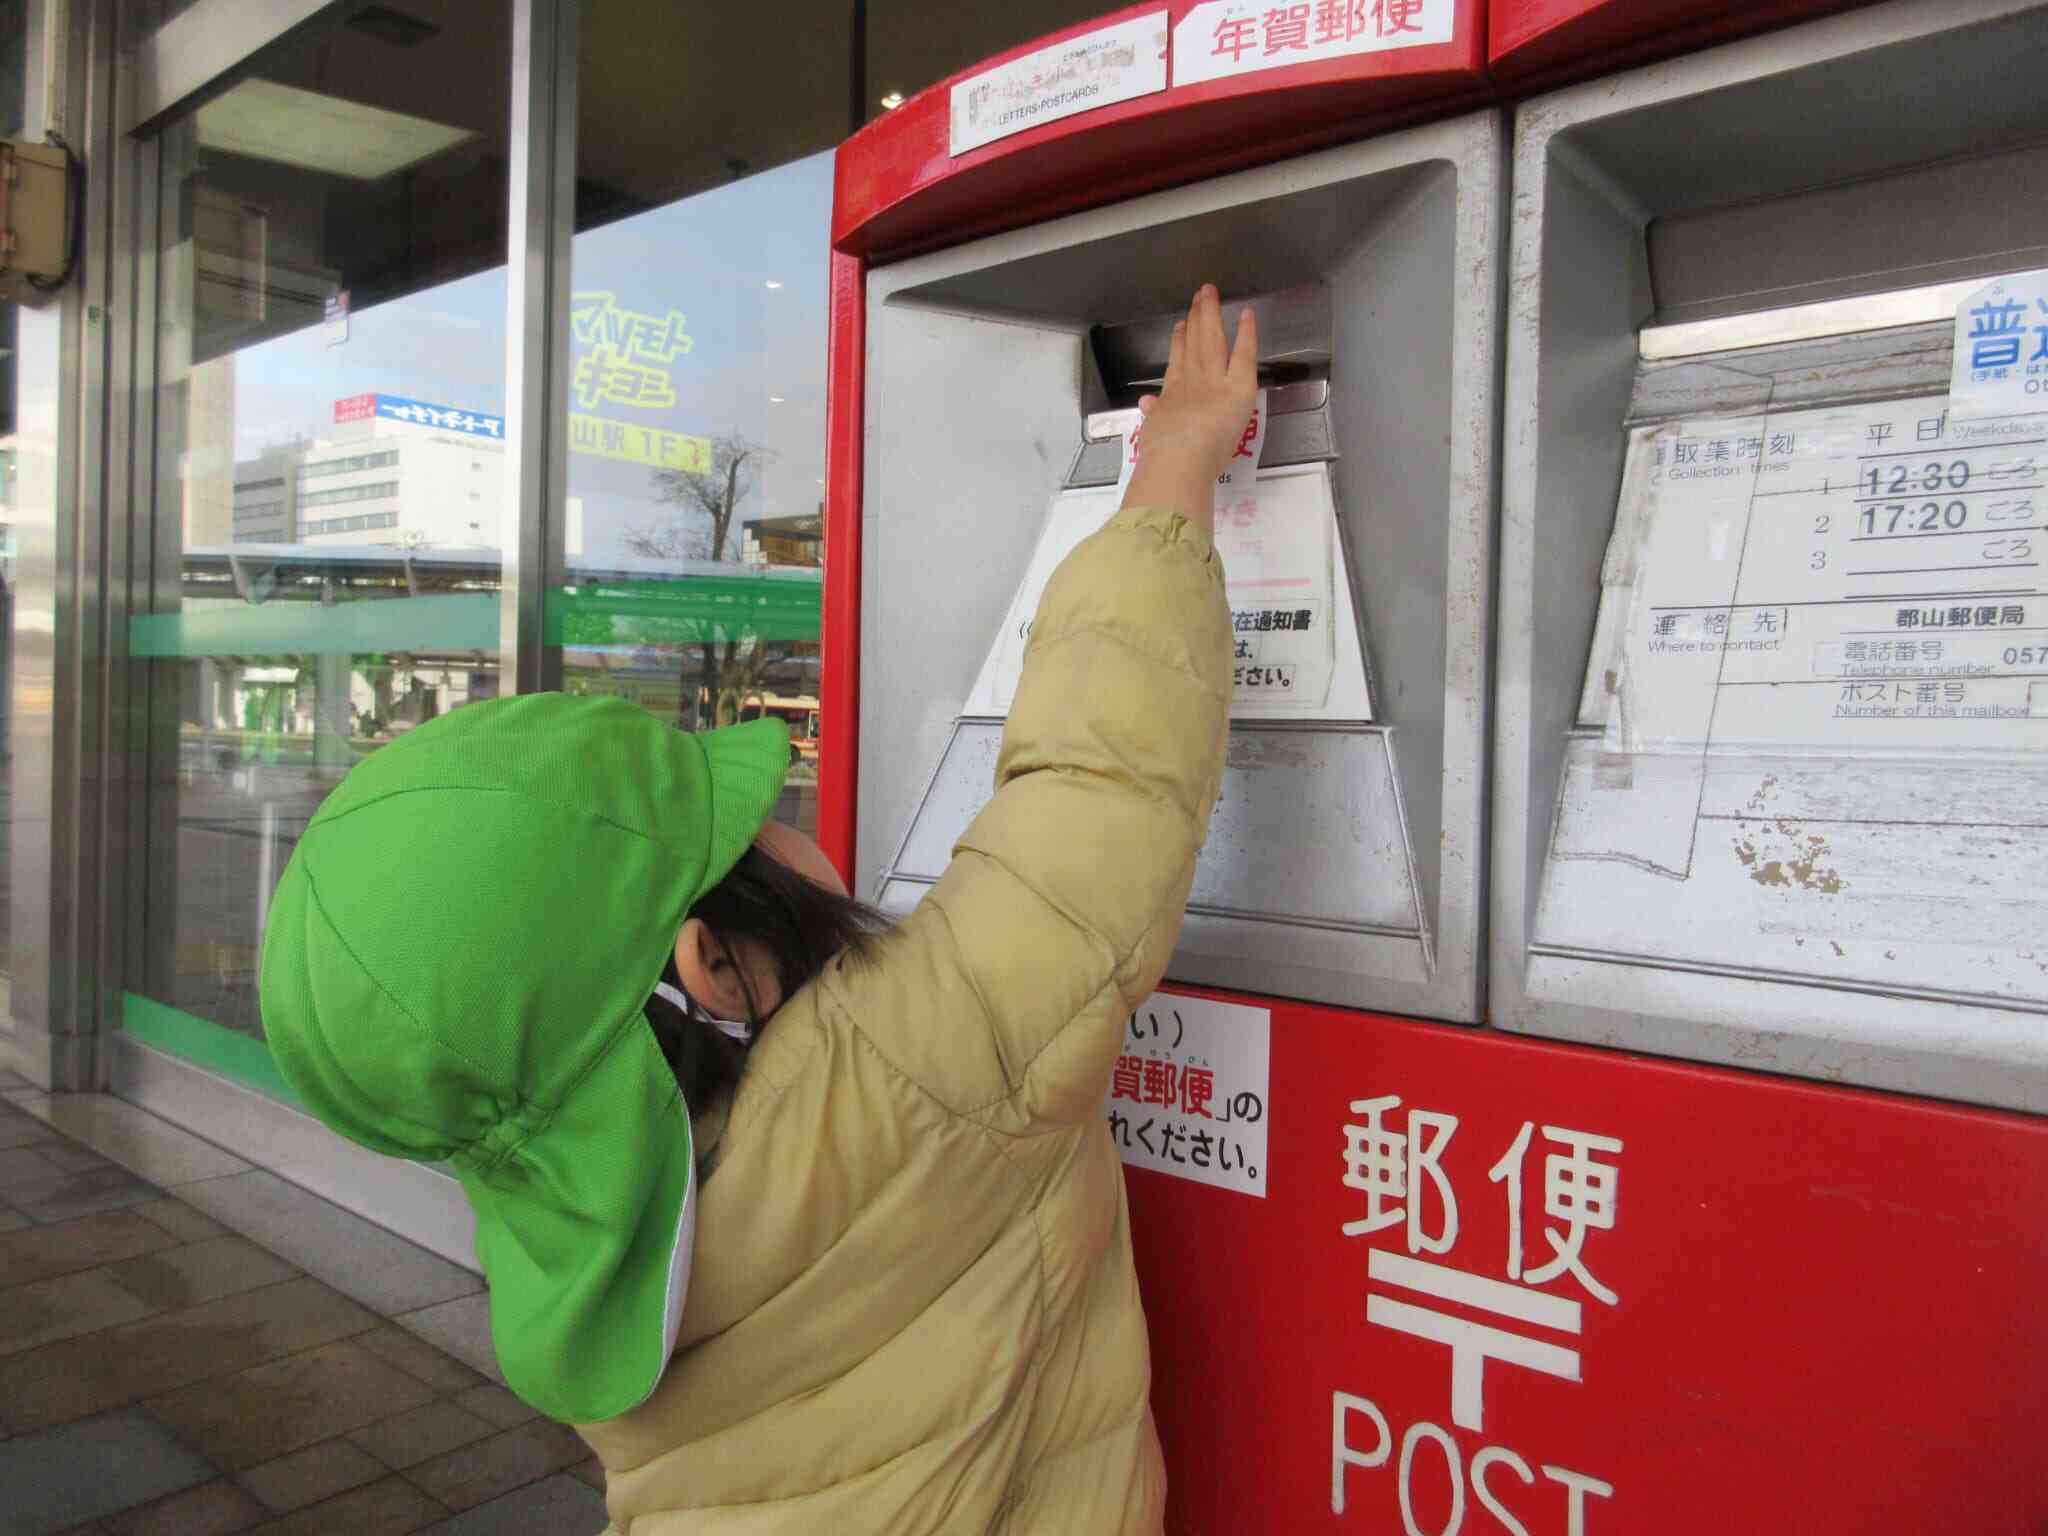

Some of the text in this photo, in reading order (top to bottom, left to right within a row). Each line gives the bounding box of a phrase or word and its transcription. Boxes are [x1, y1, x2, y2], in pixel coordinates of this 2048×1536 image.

[1210, 0, 1424, 63] 年賀郵便
[1673, 431, 1795, 465] 取集時刻
[1867, 419, 1942, 445] 平日
[1865, 458, 1971, 497] 12:30
[1814, 500, 2034, 534] 2 17:20 ころ
[1810, 538, 2032, 570] 3 ころ
[1232, 610, 1312, 632] 在通知書
[1896, 605, 2025, 628] 郡山郵便局
[1844, 640, 1945, 663] 電話番号
[1112, 1055, 1263, 1123] 賀郵便」の
[1108, 1110, 1257, 1179] れください。
[1342, 1095, 1624, 1306] 郵便
[1331, 1391, 1613, 1536] POST
